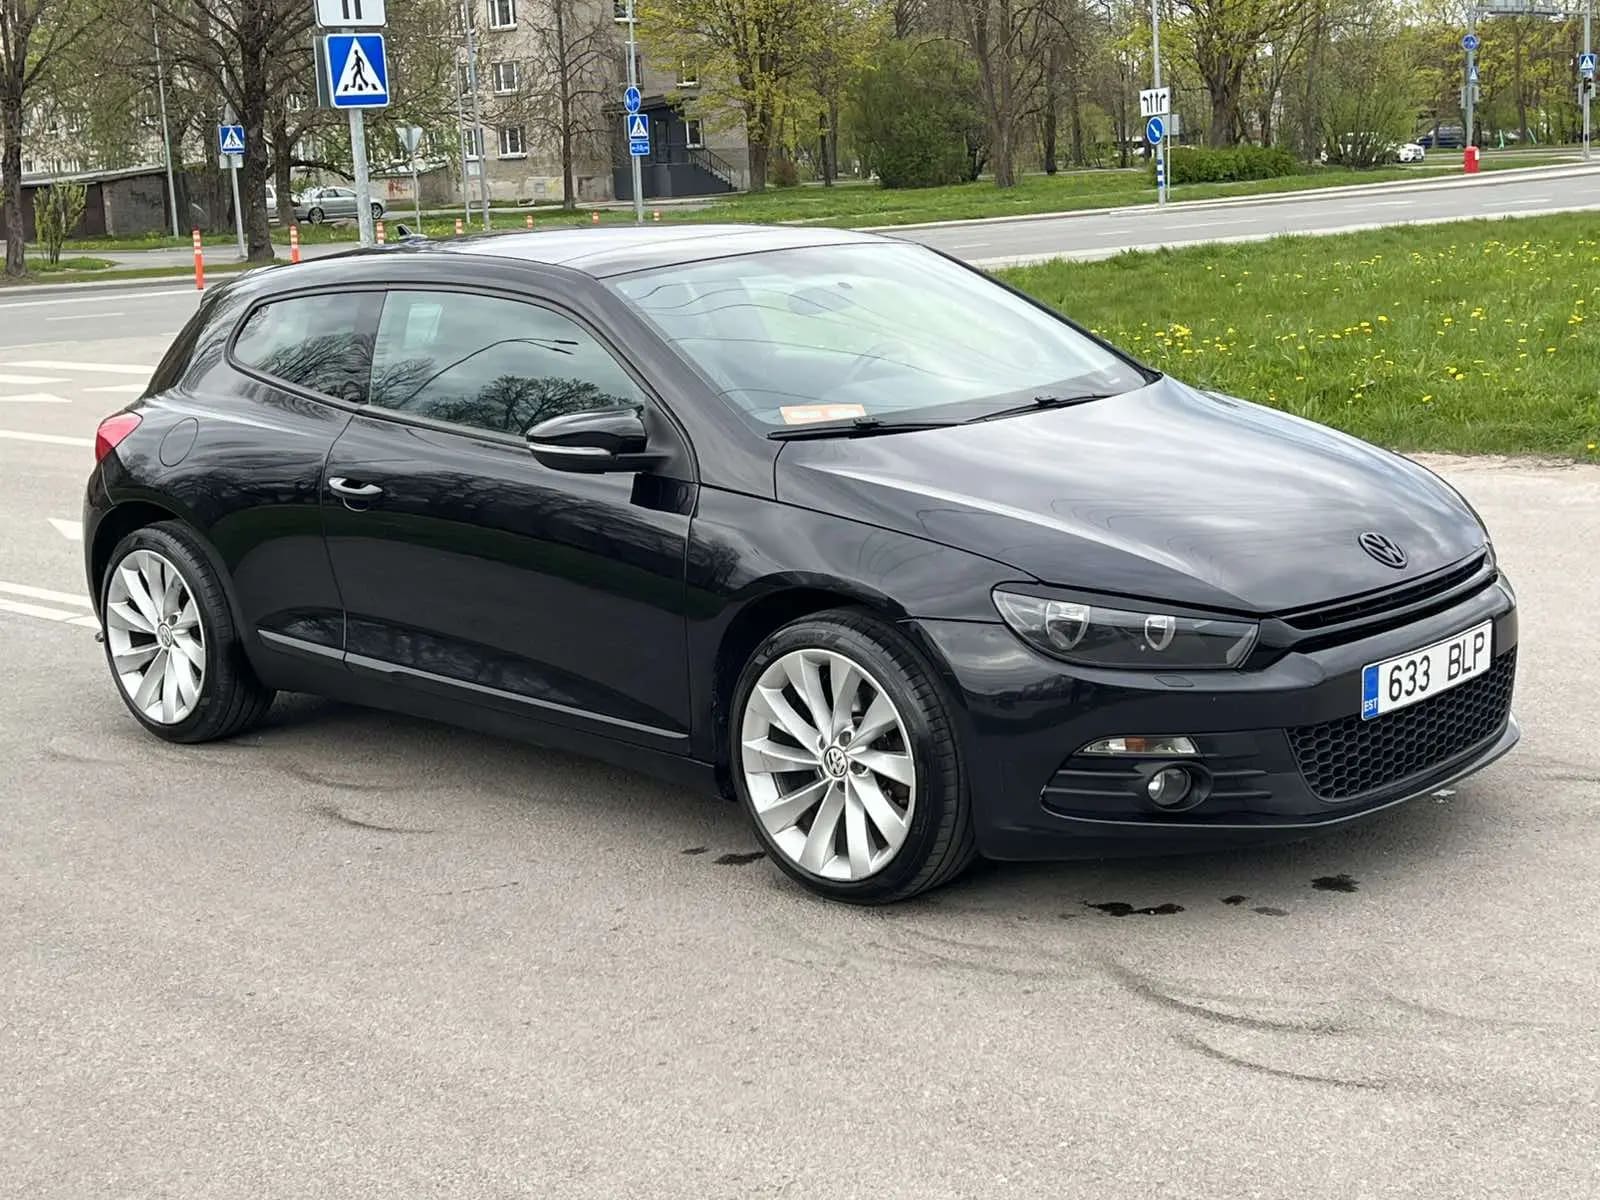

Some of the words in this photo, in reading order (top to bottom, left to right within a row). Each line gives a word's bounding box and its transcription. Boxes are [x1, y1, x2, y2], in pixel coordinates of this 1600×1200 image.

[1389, 655, 1430, 702] 633
[1448, 631, 1485, 682] BLP
[1364, 697, 1378, 712] EST
